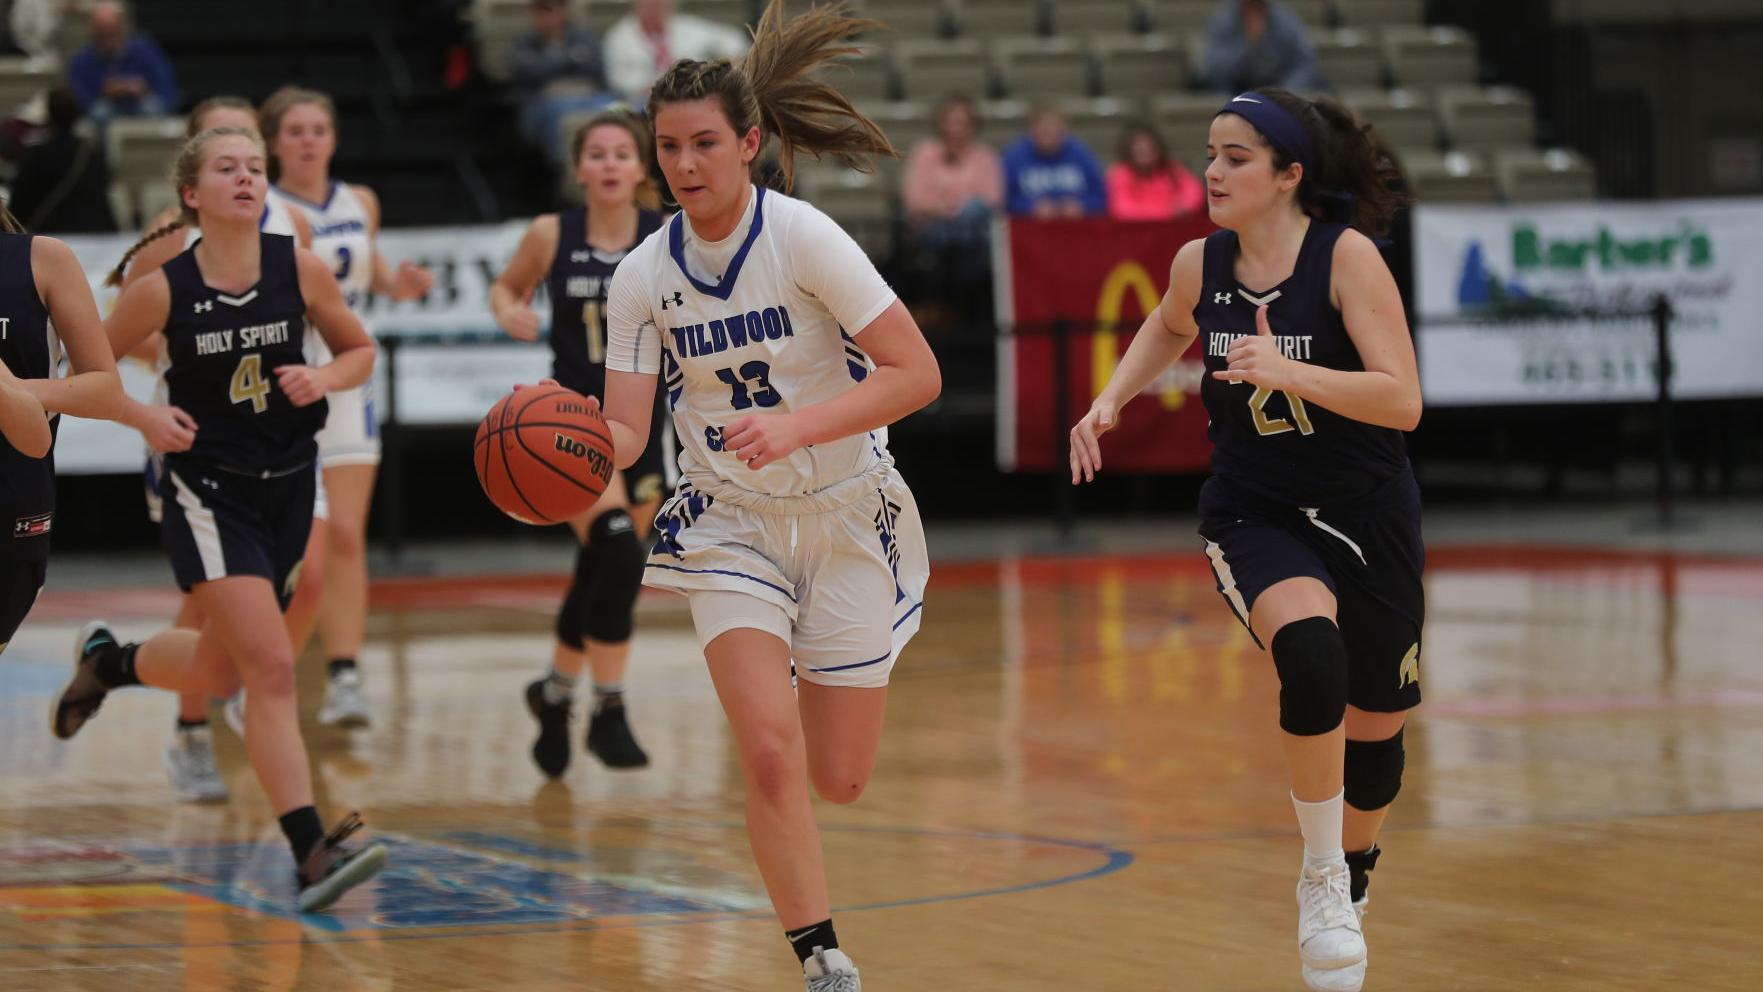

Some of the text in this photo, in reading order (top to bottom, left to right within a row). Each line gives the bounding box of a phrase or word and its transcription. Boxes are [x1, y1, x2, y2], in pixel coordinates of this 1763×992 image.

[195, 320, 288, 355] HOLY SPIRIT
[583, 300, 608, 364] 1
[1208, 331, 1313, 360] HO IRIT
[229, 353, 271, 414] 4
[715, 360, 783, 411] 13
[1229, 379, 1315, 436] 21
